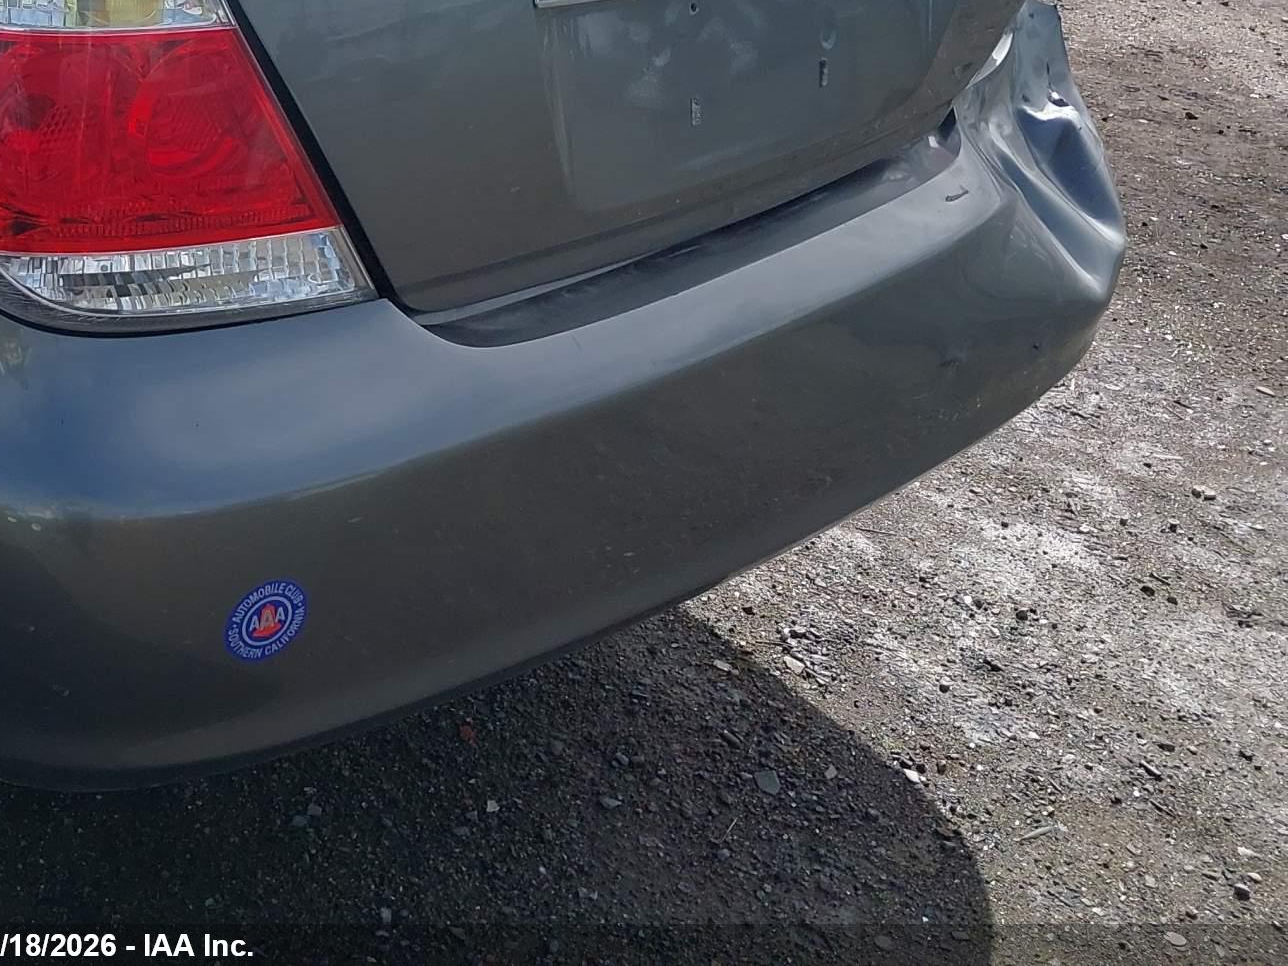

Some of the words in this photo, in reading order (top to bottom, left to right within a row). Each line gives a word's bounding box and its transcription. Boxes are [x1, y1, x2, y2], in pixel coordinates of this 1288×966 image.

[232, 582, 286, 623] AUTOMOBILE
[285, 584, 304, 604] CLUB
[249, 606, 286, 632] AAA
[228, 629, 263, 658] SOUTHERN
[264, 606, 305, 655] CALIFORNIA
